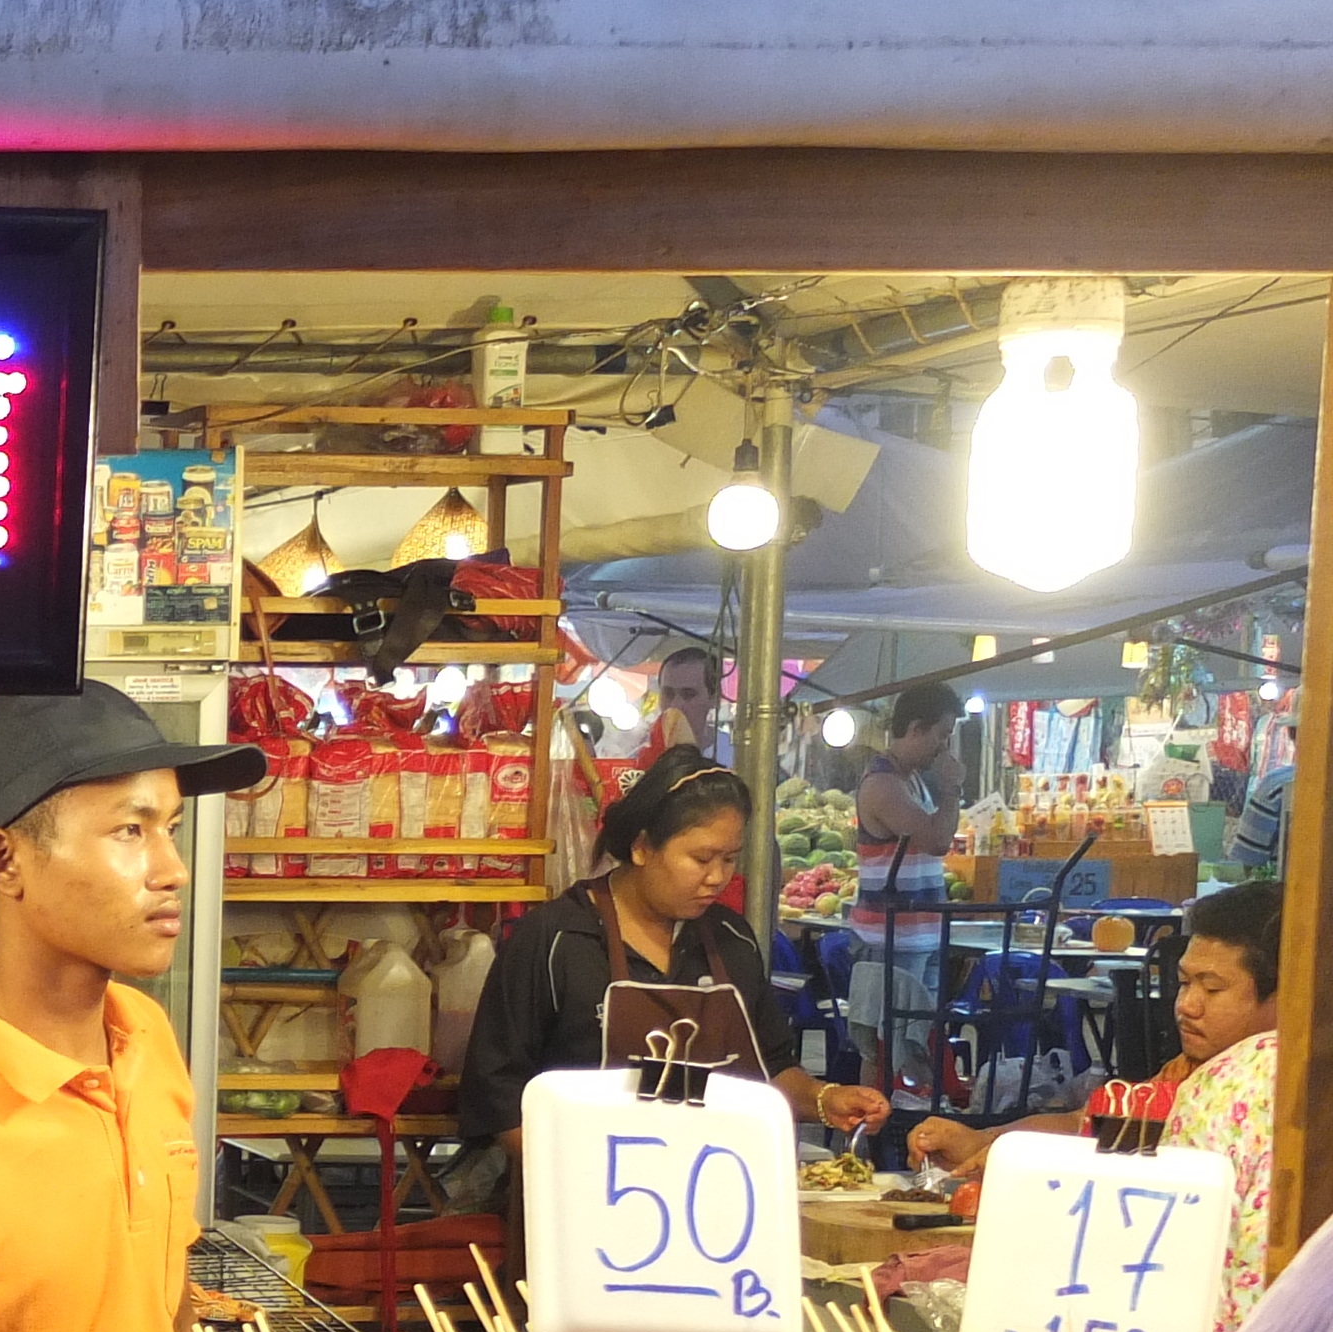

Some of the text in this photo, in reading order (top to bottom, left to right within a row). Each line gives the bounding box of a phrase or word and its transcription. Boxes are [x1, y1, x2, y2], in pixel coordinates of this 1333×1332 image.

[187, 537, 223, 551] SPAM
[1069, 872, 1096, 896] 25
[595, 1133, 755, 1273] 50
